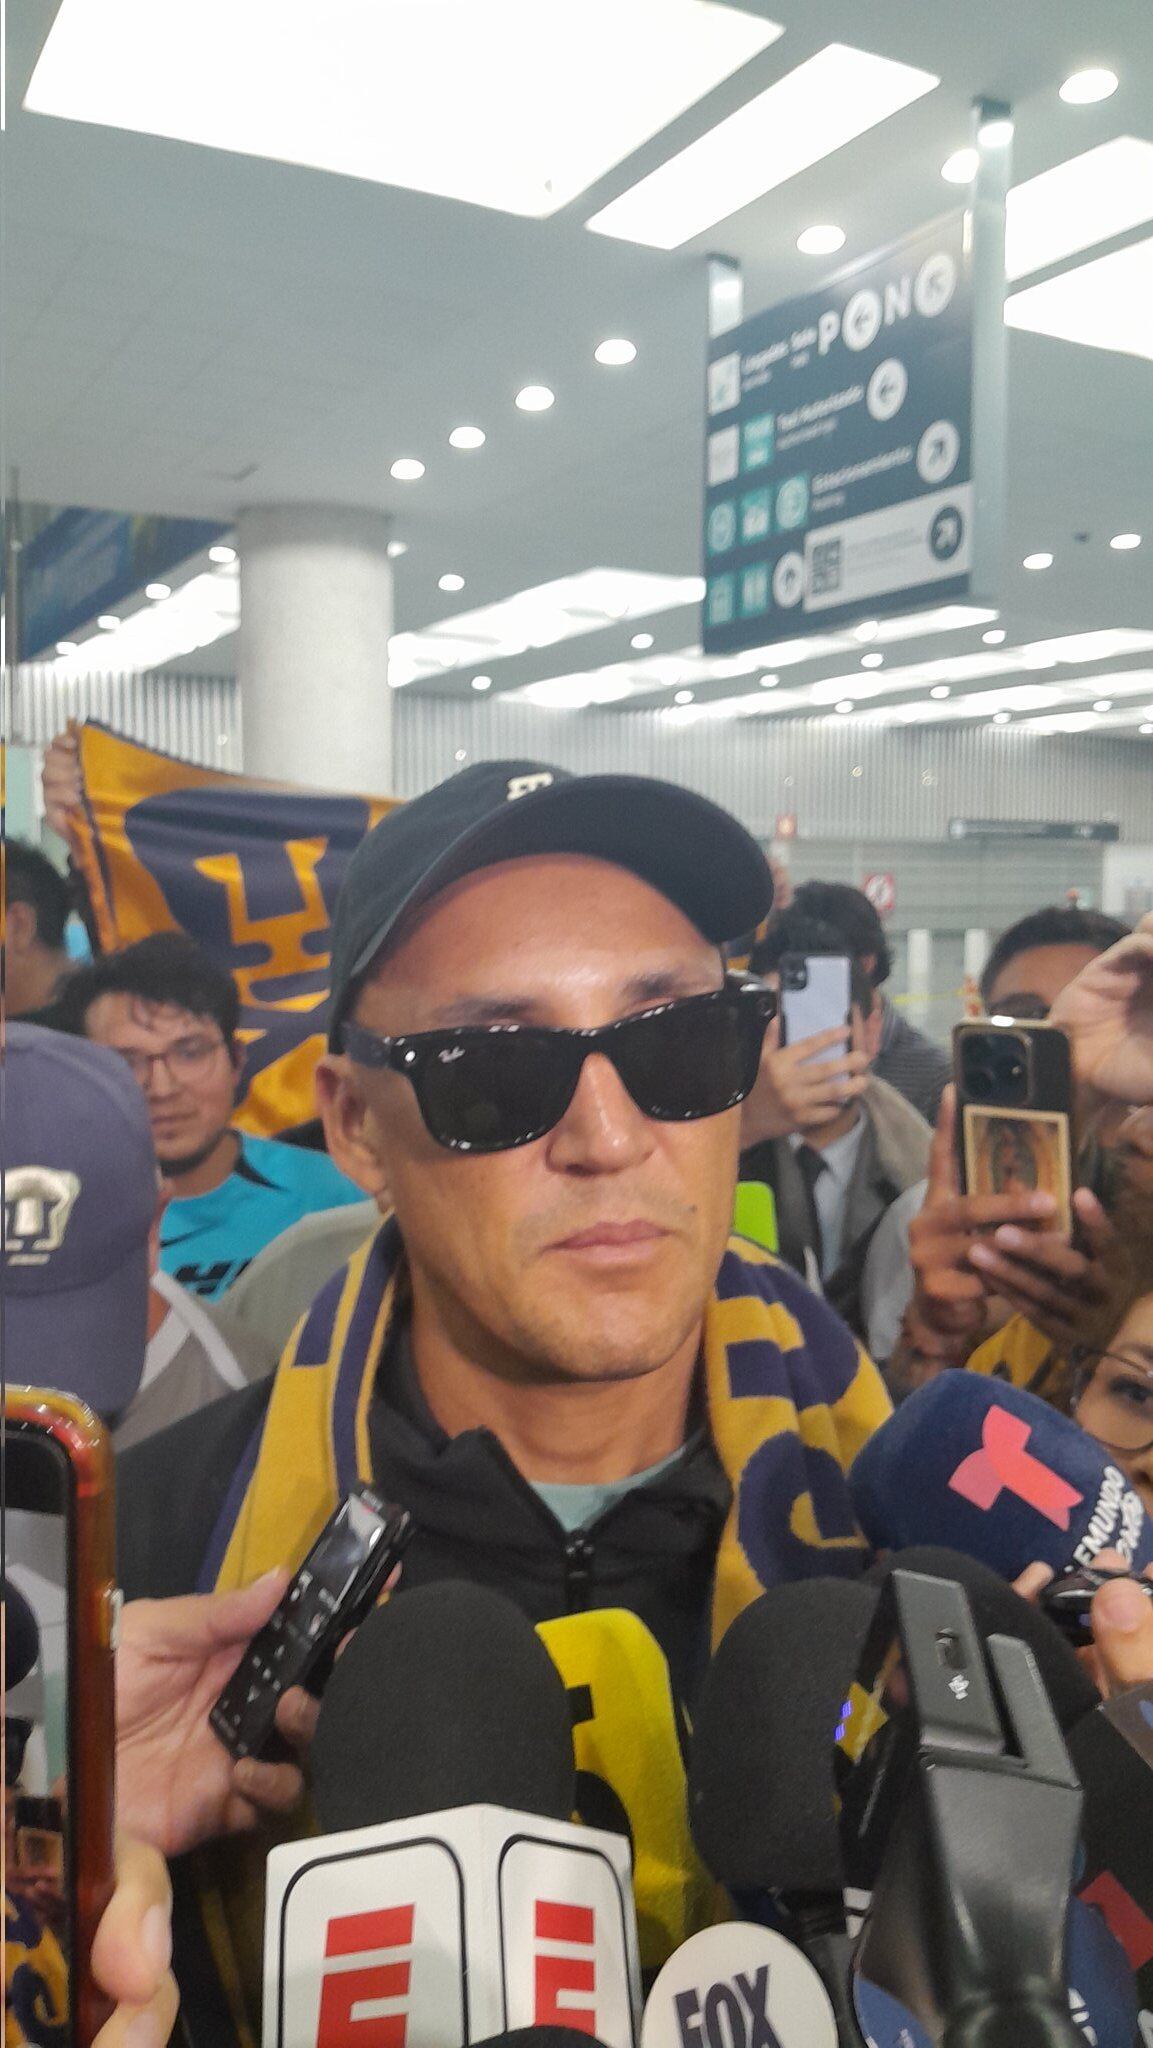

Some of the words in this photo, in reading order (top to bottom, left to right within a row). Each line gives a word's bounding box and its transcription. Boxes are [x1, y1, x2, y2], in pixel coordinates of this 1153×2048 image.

[818, 310, 840, 356] P
[884, 275, 911, 326] N
[1064, 1465, 1126, 1573] EMUNDO
[674, 1964, 784, 2048] FOX
